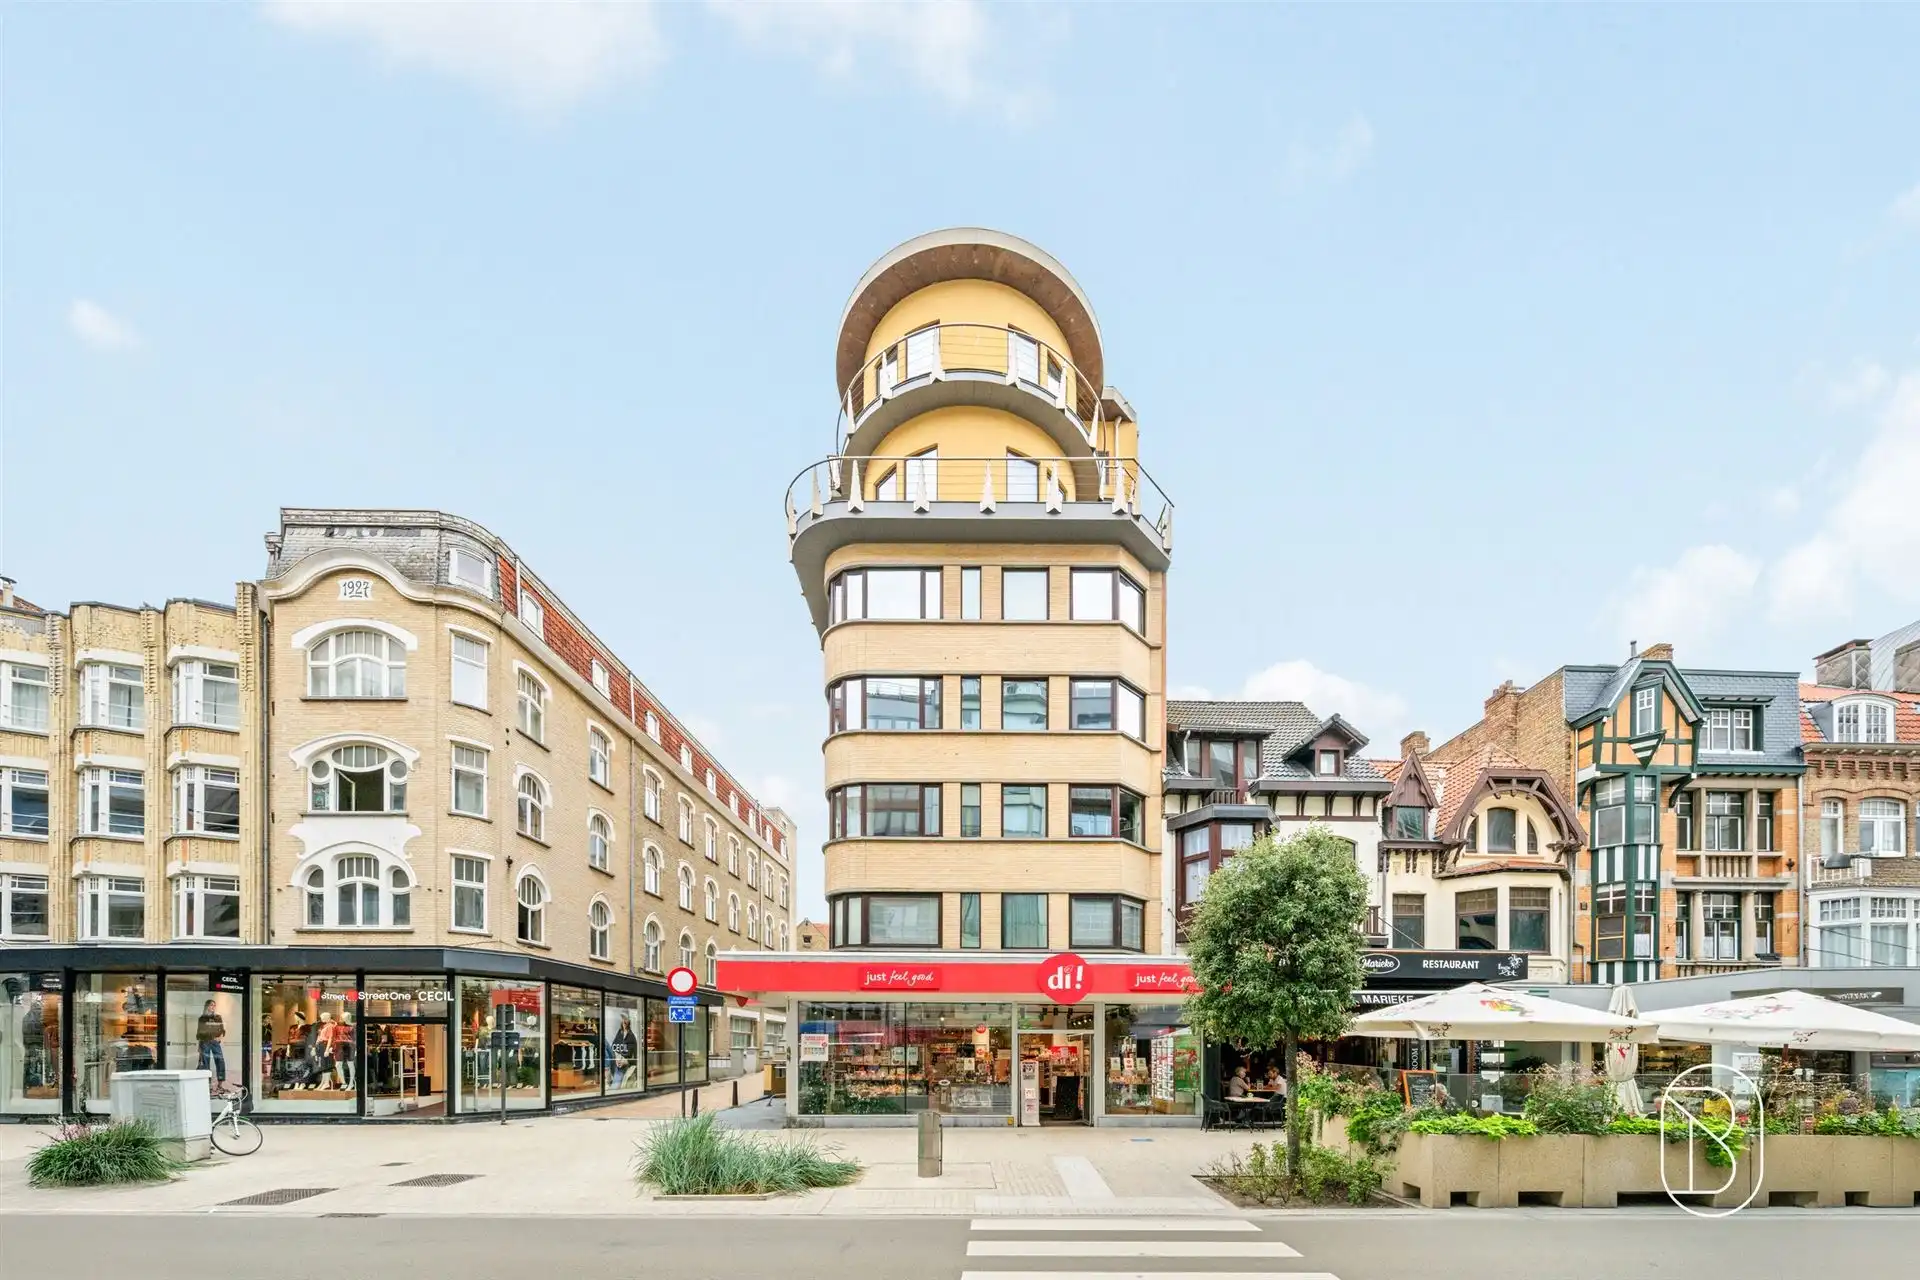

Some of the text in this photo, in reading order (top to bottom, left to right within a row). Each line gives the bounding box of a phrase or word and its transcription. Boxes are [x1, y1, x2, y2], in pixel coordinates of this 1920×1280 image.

[343, 580, 369, 598] 1927
[1361, 958, 1395, 969] Marieke
[1422, 960, 1479, 969] RESTAURANT
[864, 970, 934, 986] just feel good
[1047, 965, 1083, 990] di!
[1134, 973, 1156, 987] just
[1157, 972, 1177, 988] feel
[418, 991, 454, 1001] CECIL
[1361, 995, 1414, 1004] MARIEKE
[612, 1043, 628, 1052] CECIL
